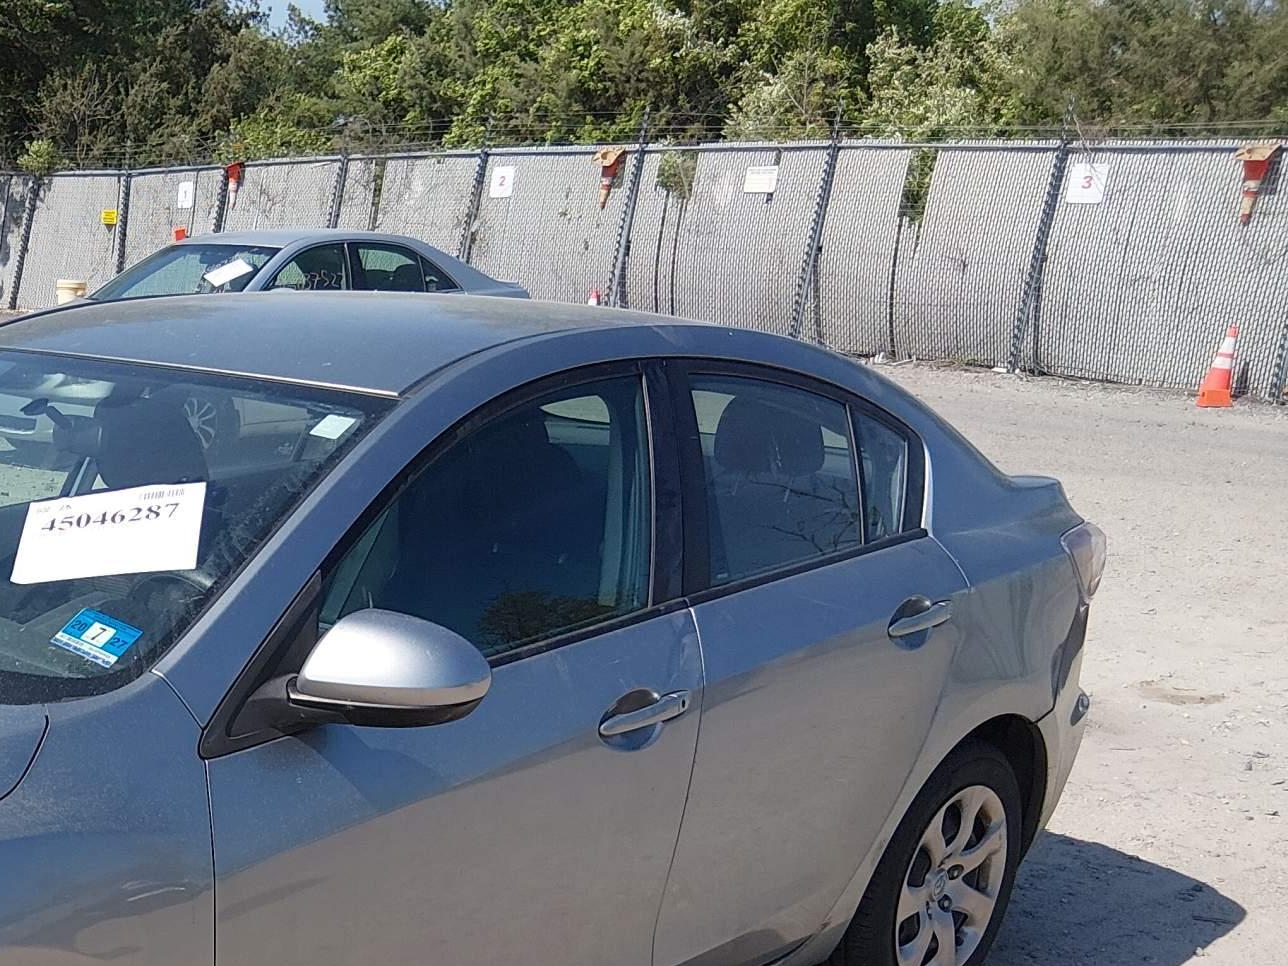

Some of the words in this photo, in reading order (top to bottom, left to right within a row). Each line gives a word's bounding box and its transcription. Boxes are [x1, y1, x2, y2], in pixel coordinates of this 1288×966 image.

[498, 175, 506, 187] 2
[1081, 175, 1093, 189] 3
[41, 502, 180, 532] 45046287
[71, 619, 88, 632] 20
[91, 626, 107, 641] 7
[109, 637, 128, 649] 27
